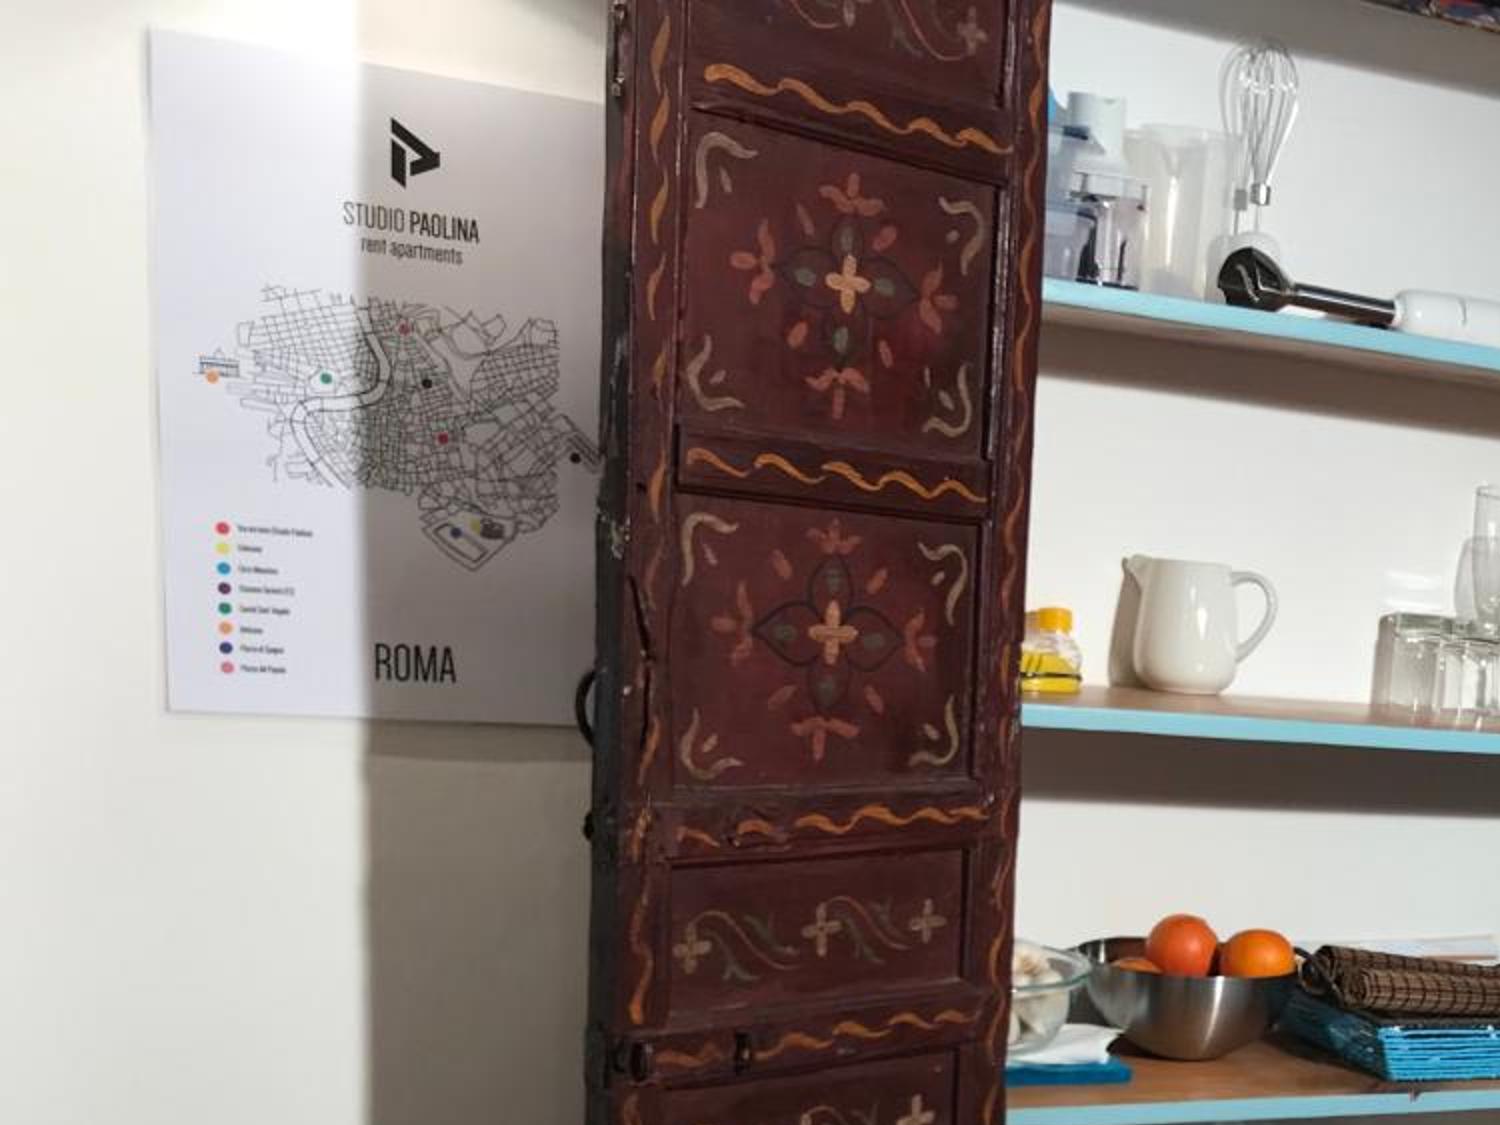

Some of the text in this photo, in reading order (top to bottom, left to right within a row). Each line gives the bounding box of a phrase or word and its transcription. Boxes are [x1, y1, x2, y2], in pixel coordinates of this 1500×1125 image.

[343, 201, 480, 244] STUDIO PAOLINA
[361, 237, 464, 265] rent apartments
[375, 643, 457, 684] ROMA
